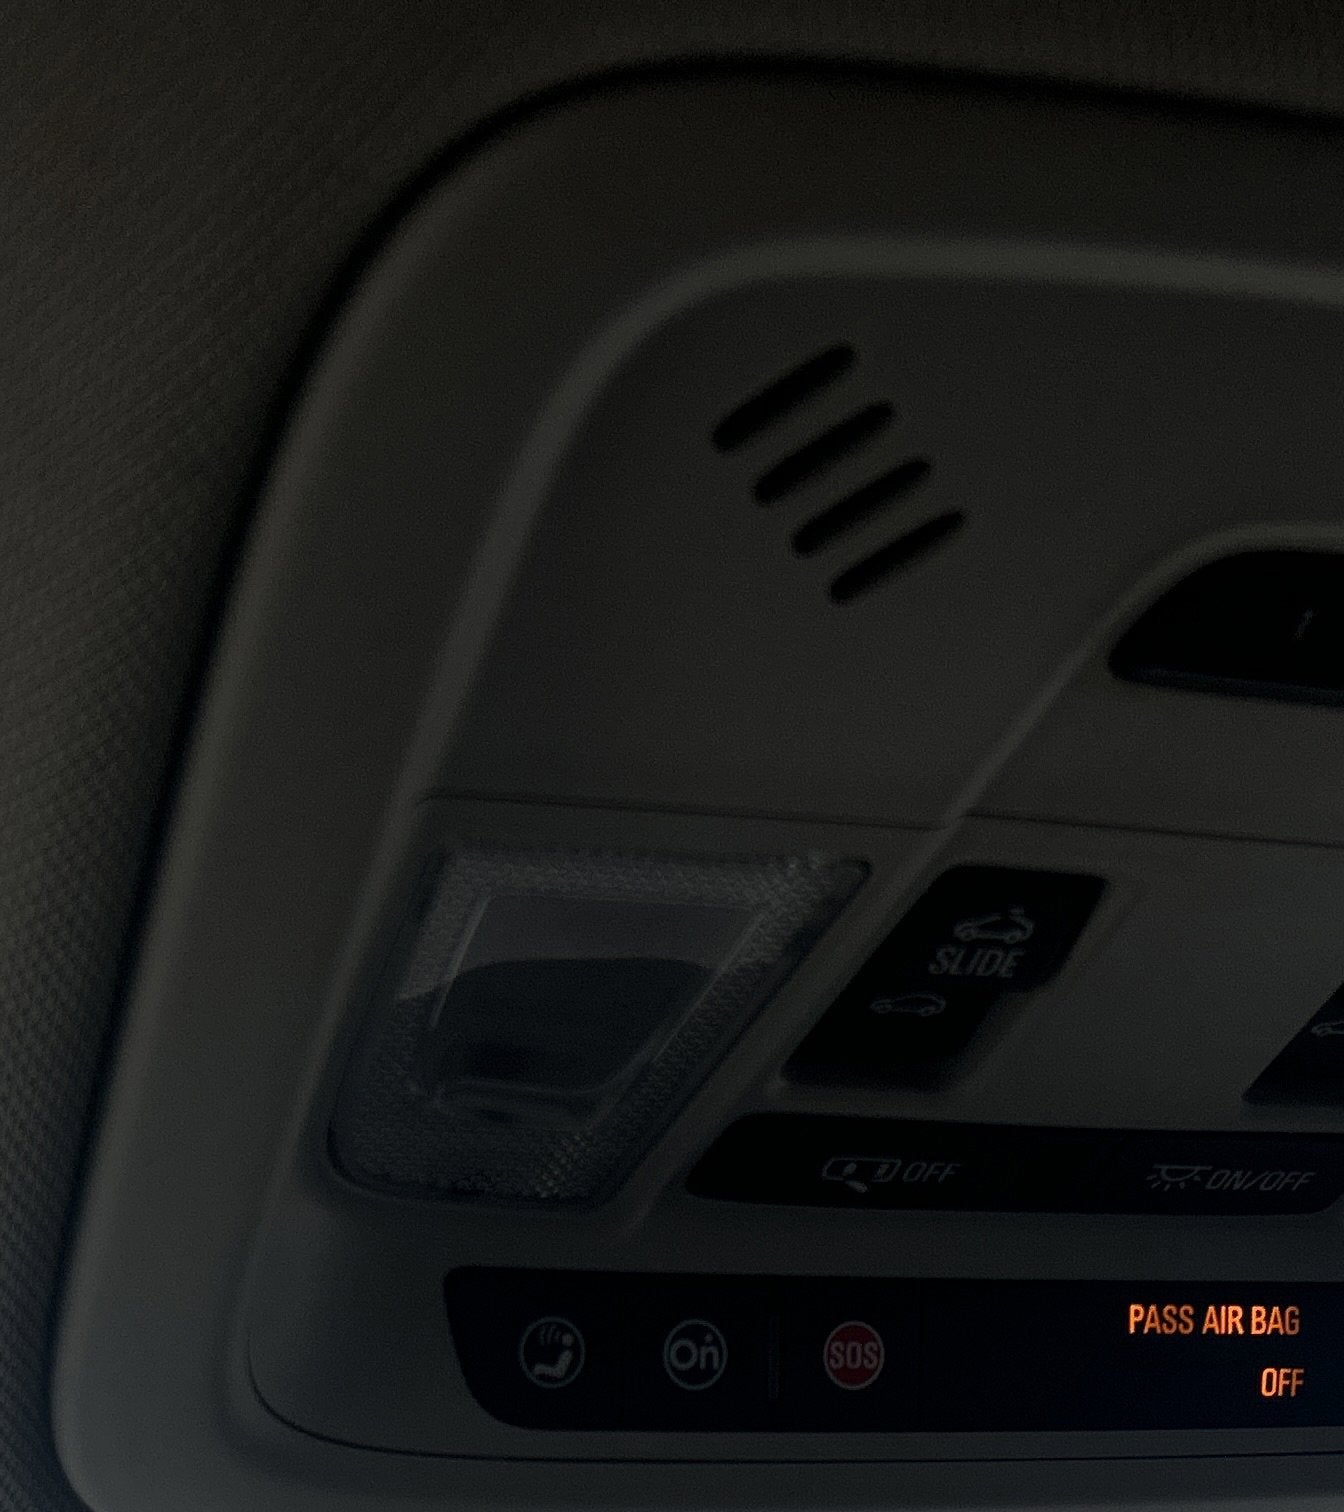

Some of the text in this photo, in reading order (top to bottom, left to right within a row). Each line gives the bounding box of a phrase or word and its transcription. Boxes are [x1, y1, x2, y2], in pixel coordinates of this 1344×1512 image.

[927, 945, 1025, 978] SLIDE
[903, 1161, 962, 1183] OFF
[1206, 1168, 1316, 1191] ON/OFF
[1128, 1303, 1301, 1337] PASS AIR BAG
[828, 1340, 882, 1370] SOS
[1259, 1367, 1306, 1398] OFF
